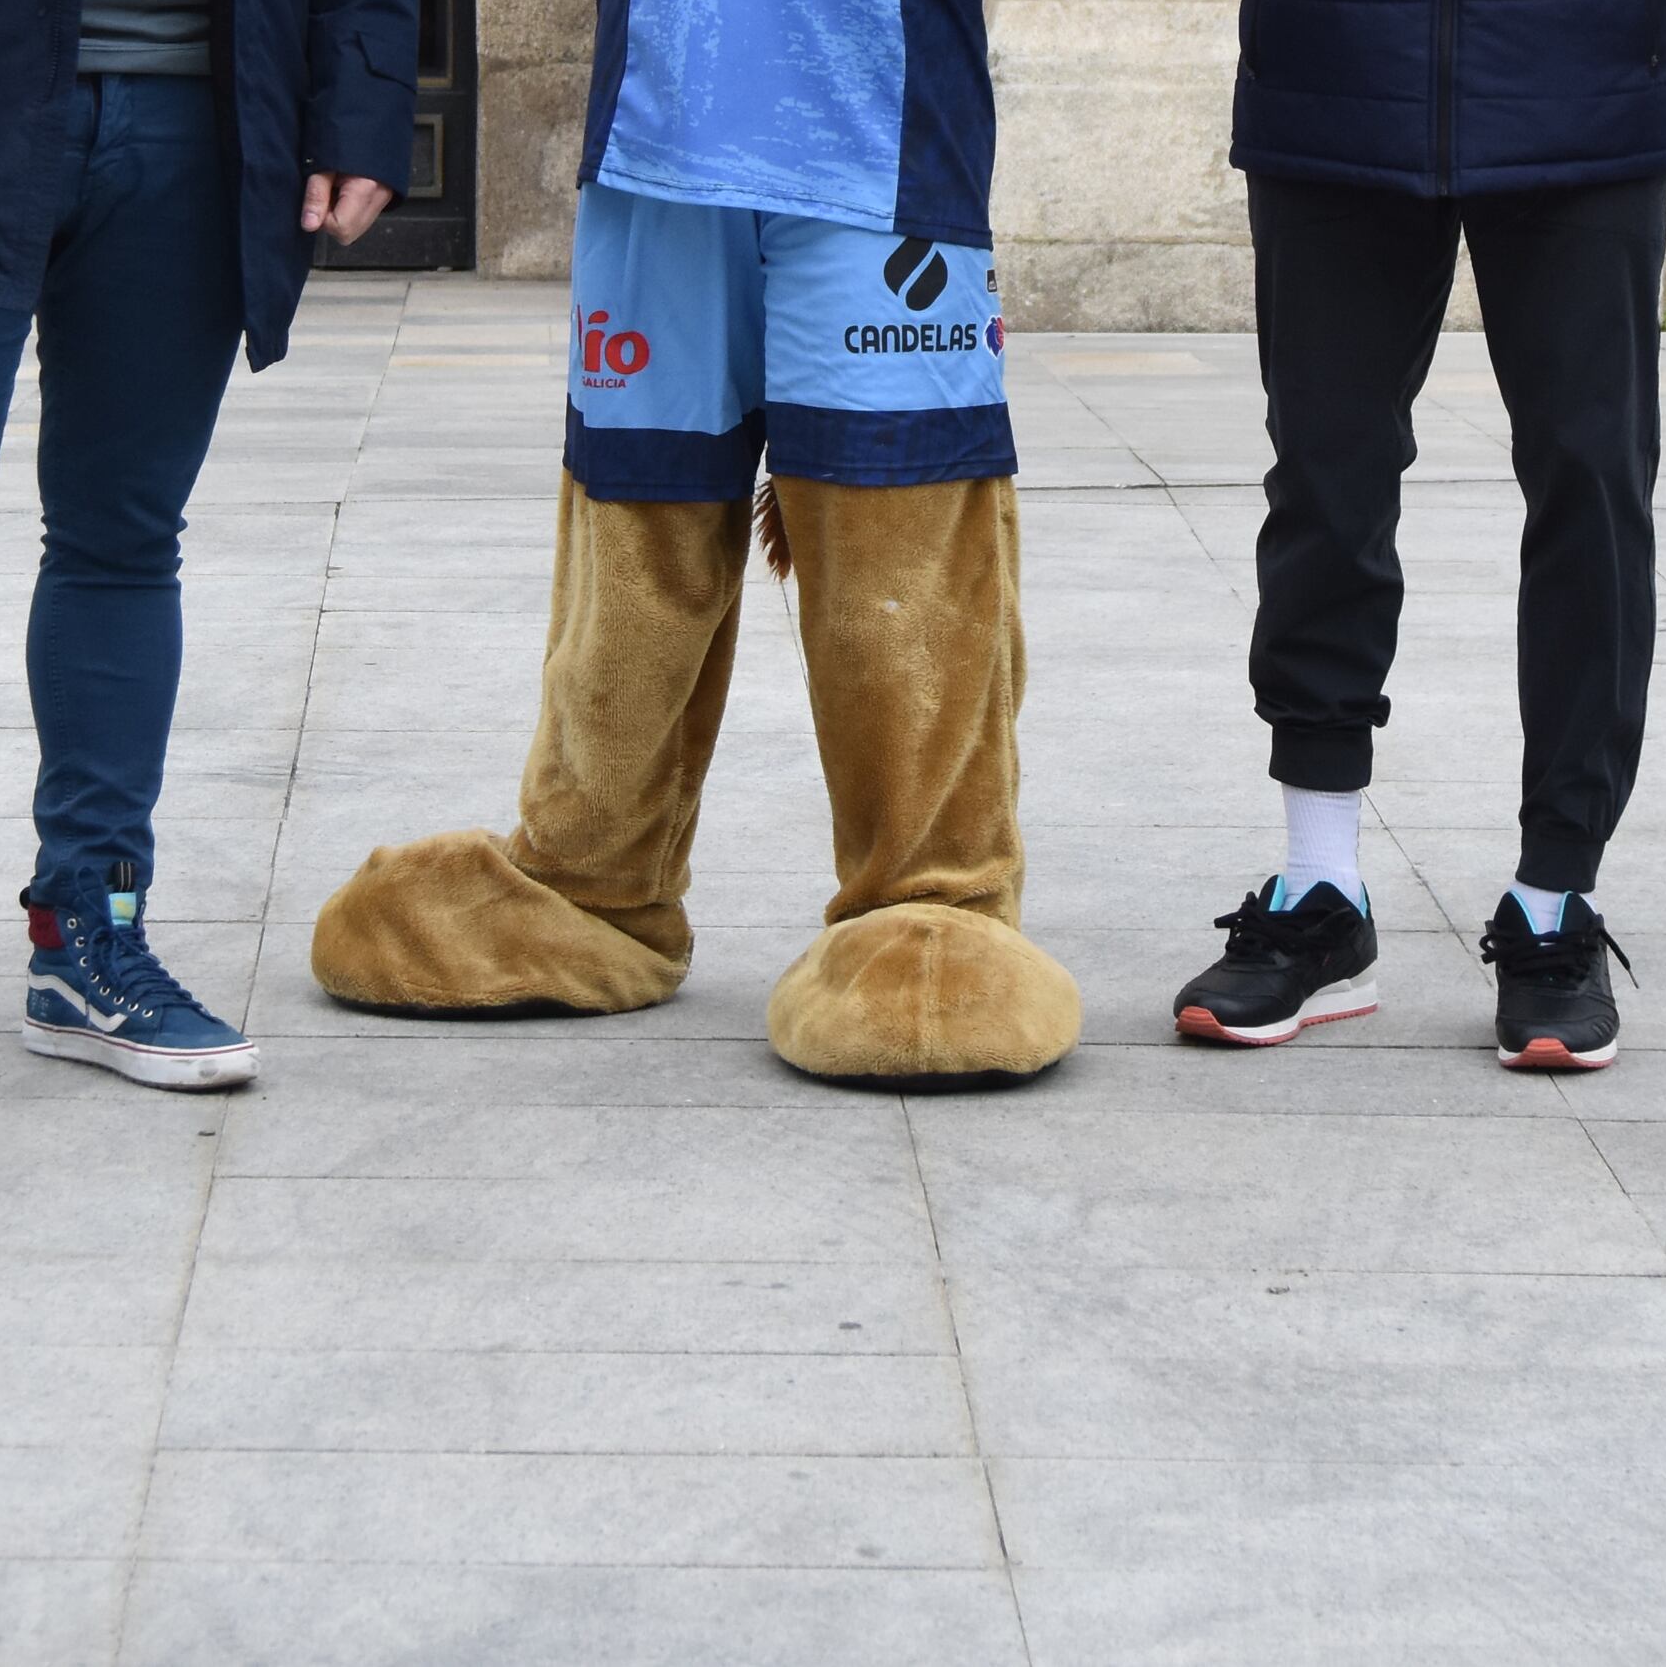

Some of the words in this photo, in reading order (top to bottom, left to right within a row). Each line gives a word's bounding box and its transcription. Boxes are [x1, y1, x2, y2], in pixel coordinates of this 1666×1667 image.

[577, 304, 650, 375] ío
[844, 323, 977, 354] CANDELAS
[582, 375, 627, 389] ALICIA
